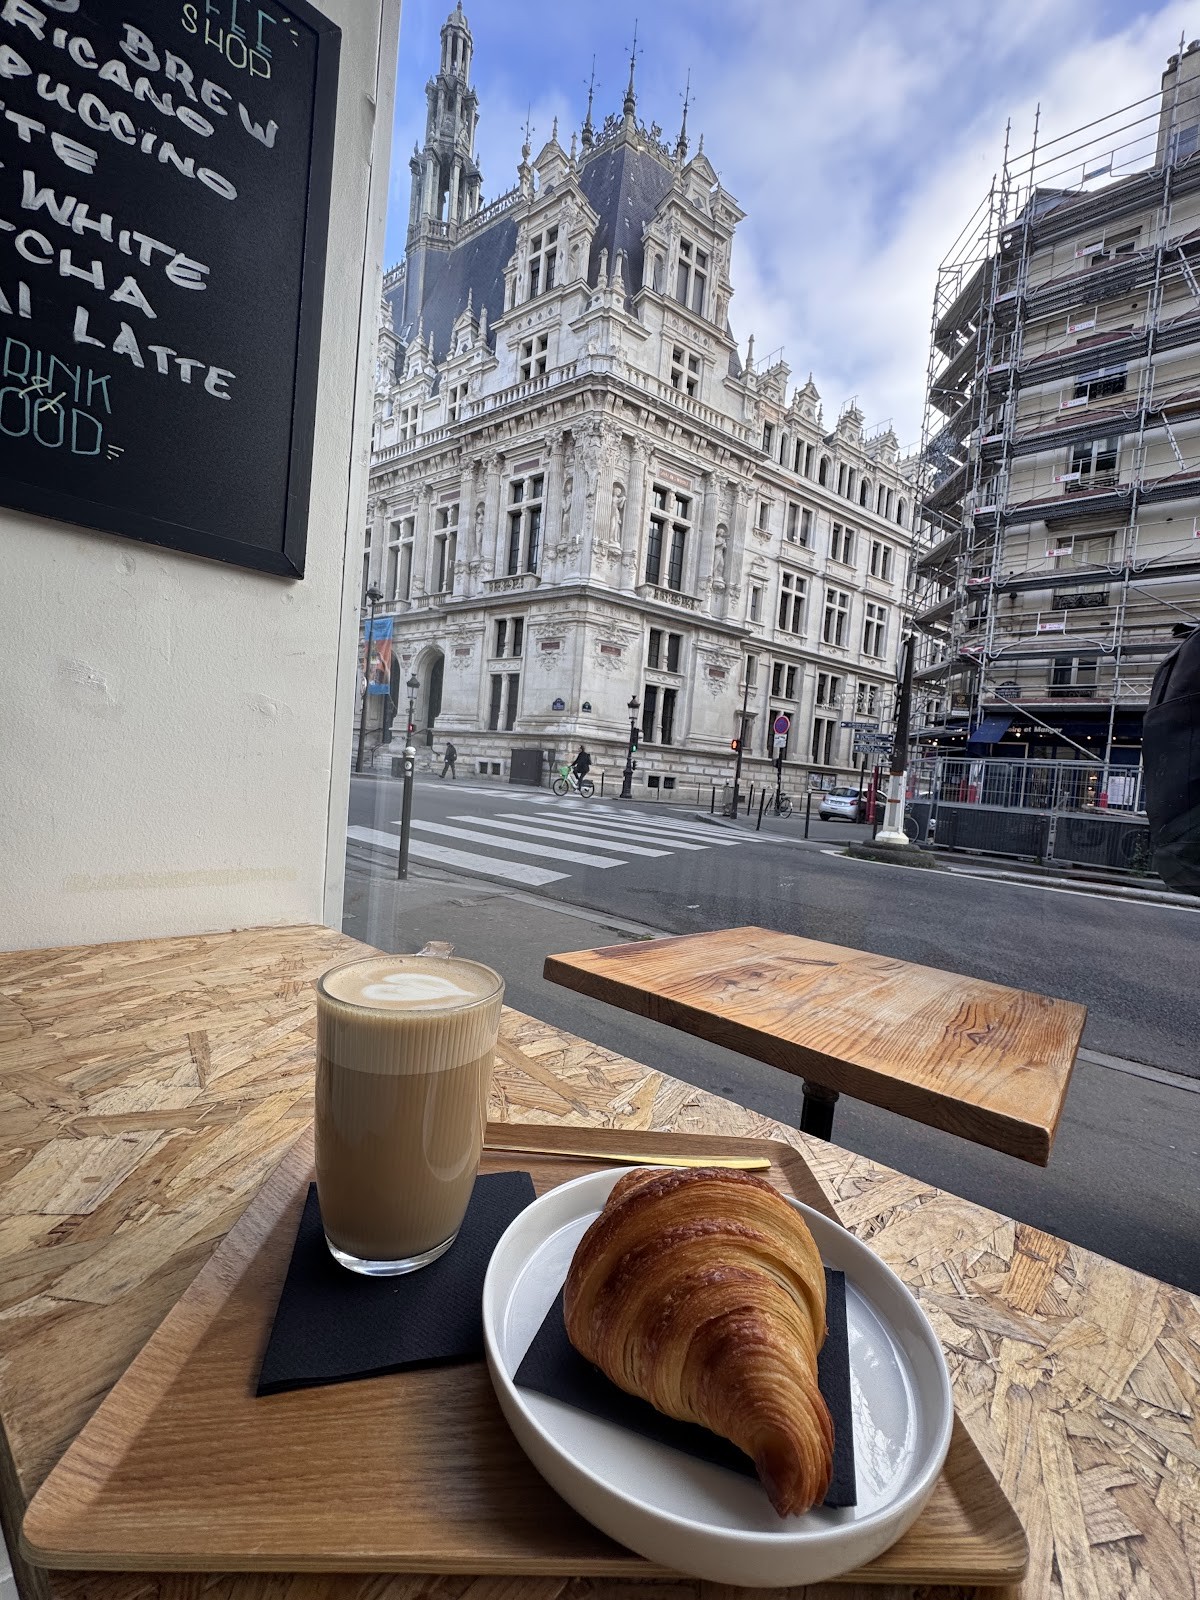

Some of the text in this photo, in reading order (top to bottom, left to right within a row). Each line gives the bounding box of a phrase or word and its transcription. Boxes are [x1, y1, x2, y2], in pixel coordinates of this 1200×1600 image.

[119, 22, 279, 149] BREW
[181, 3, 271, 79] SHOP
[21, 169, 211, 290] WHITE
[73, 305, 236, 400] LATTE
